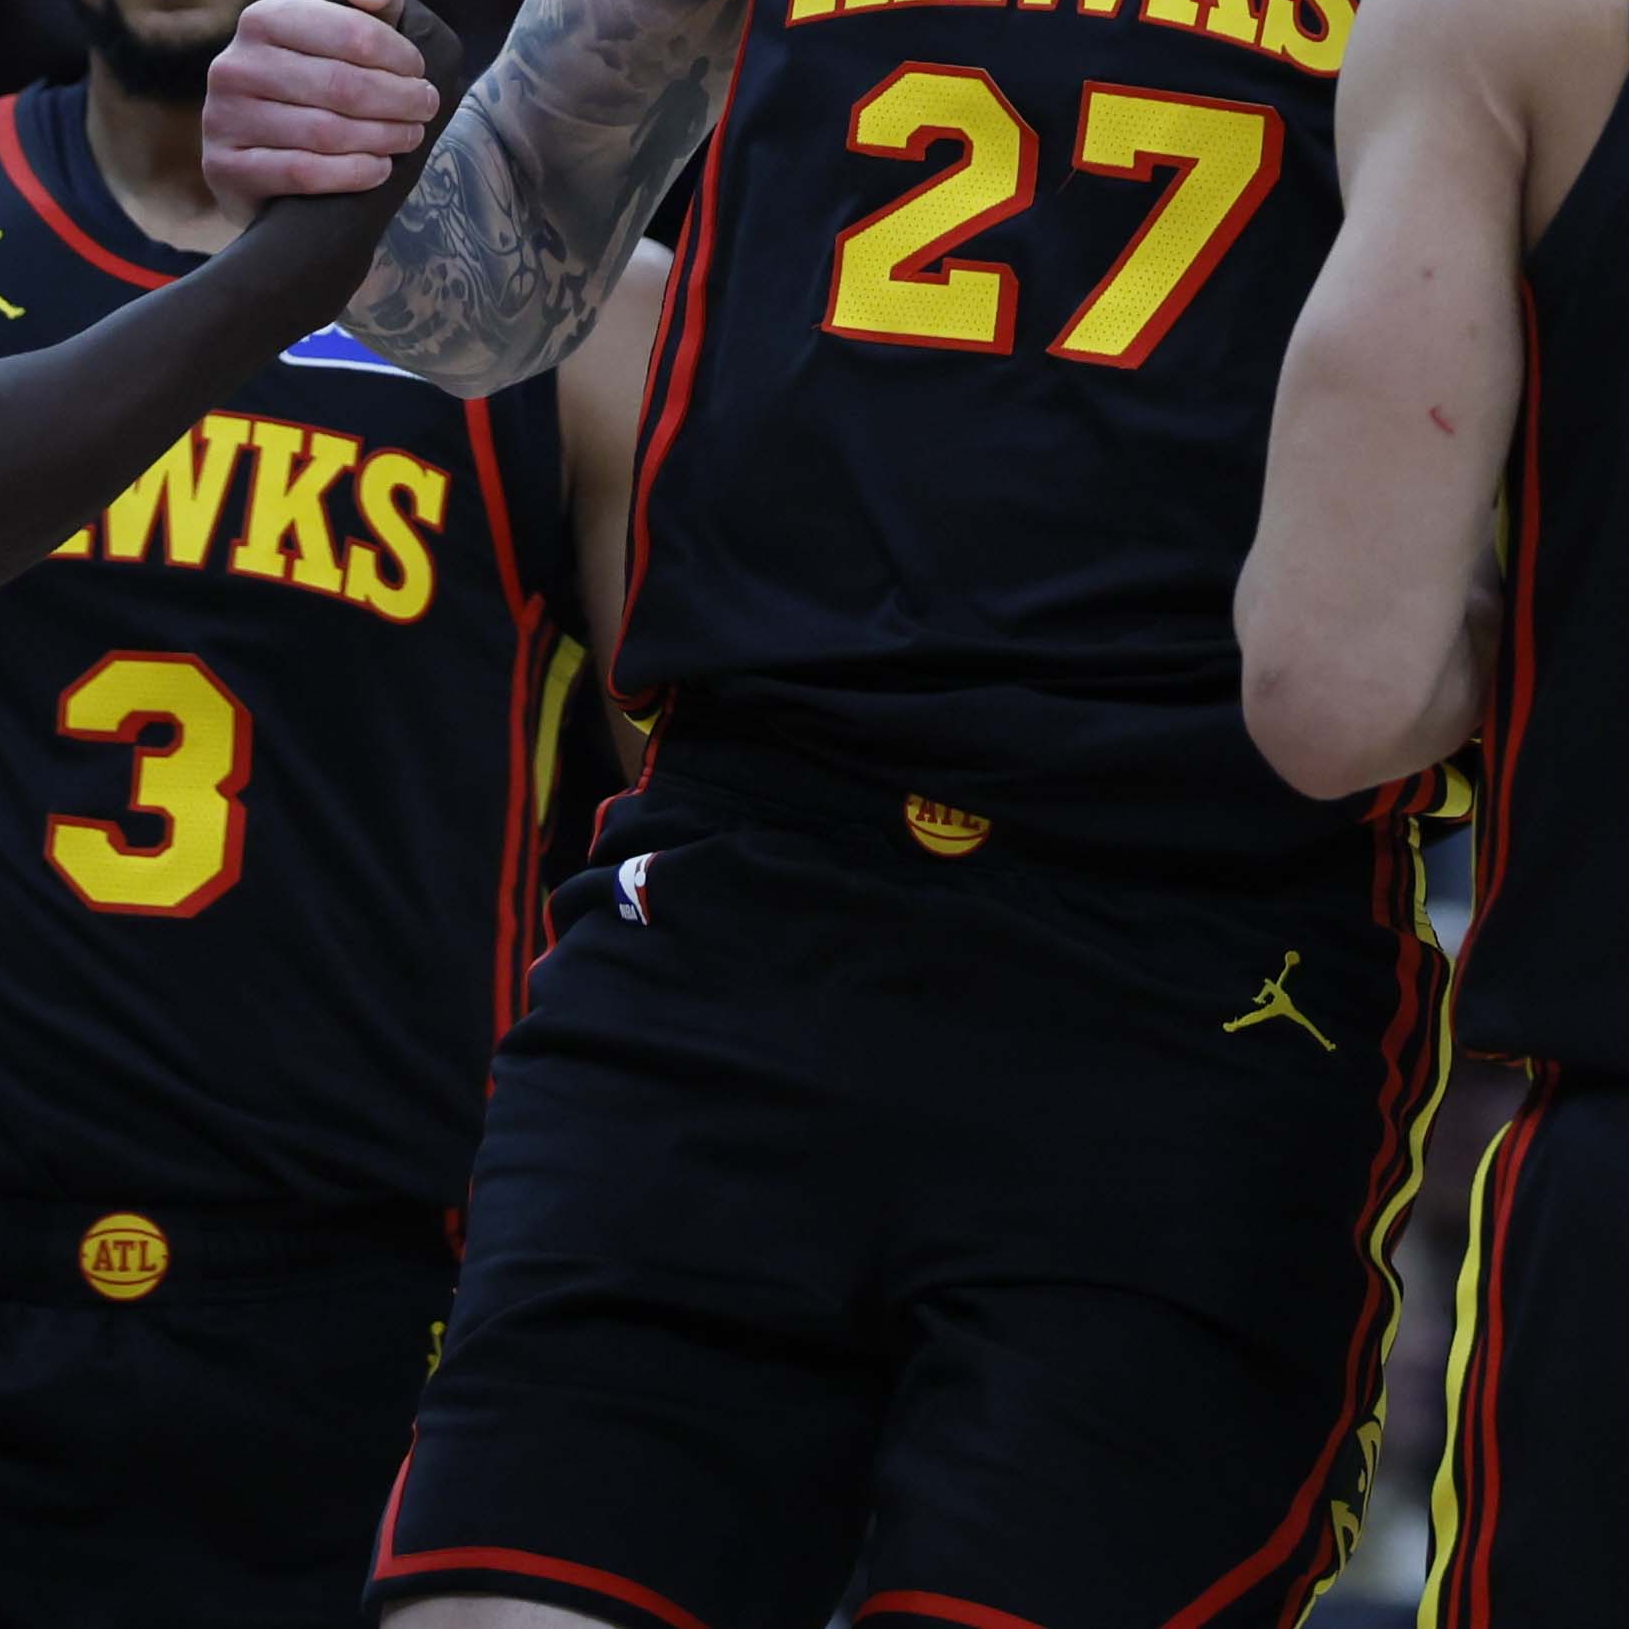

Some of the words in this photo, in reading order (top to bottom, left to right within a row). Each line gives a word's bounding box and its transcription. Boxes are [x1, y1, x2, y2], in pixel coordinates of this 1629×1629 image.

[821, 60, 1285, 370] 27
[47, 408, 452, 625] WKS
[43, 649, 255, 919] 3
[92, 1239, 157, 1272] ATL
